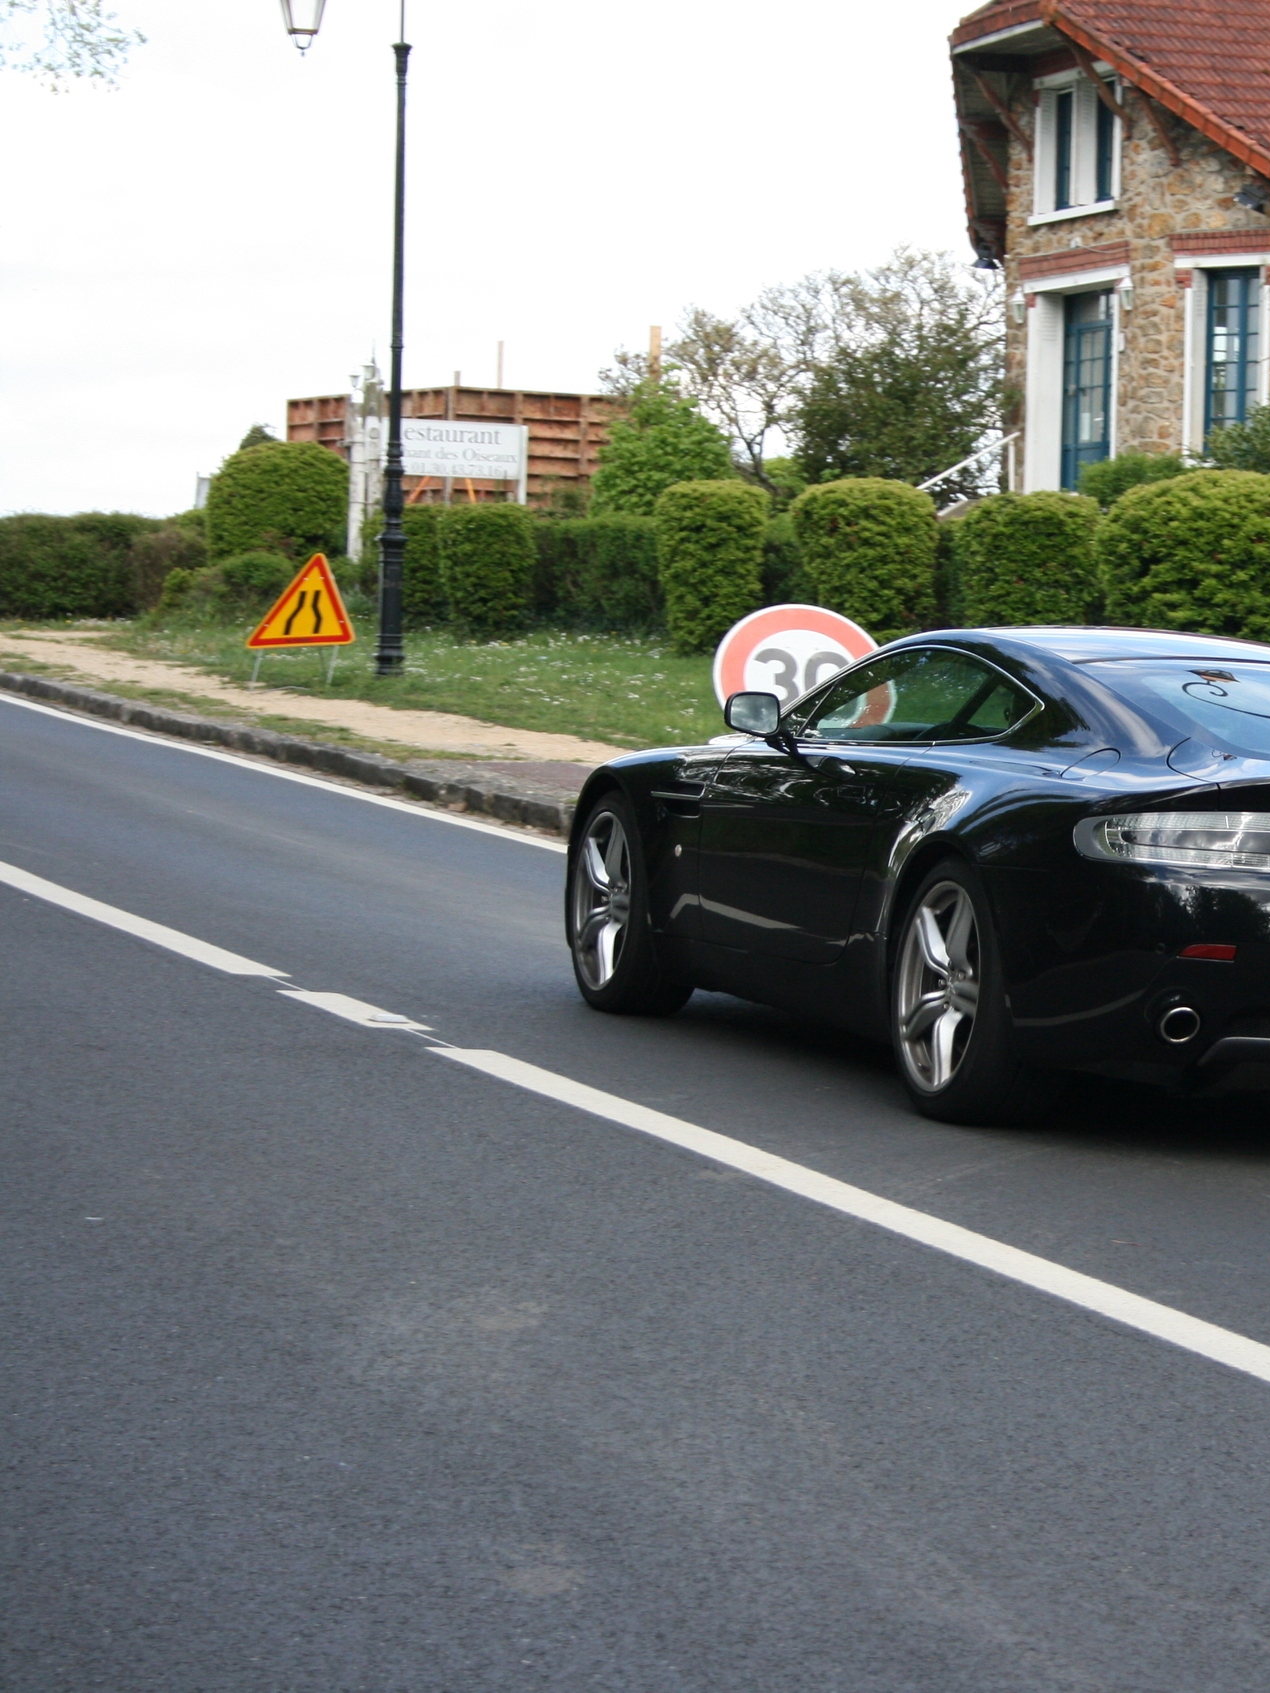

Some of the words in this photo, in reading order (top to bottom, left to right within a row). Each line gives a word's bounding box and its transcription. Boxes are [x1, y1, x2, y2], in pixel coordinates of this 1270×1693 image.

[404, 426, 501, 445] estaurant
[435, 447, 458, 460] des
[462, 448, 517, 463] Oiseaux
